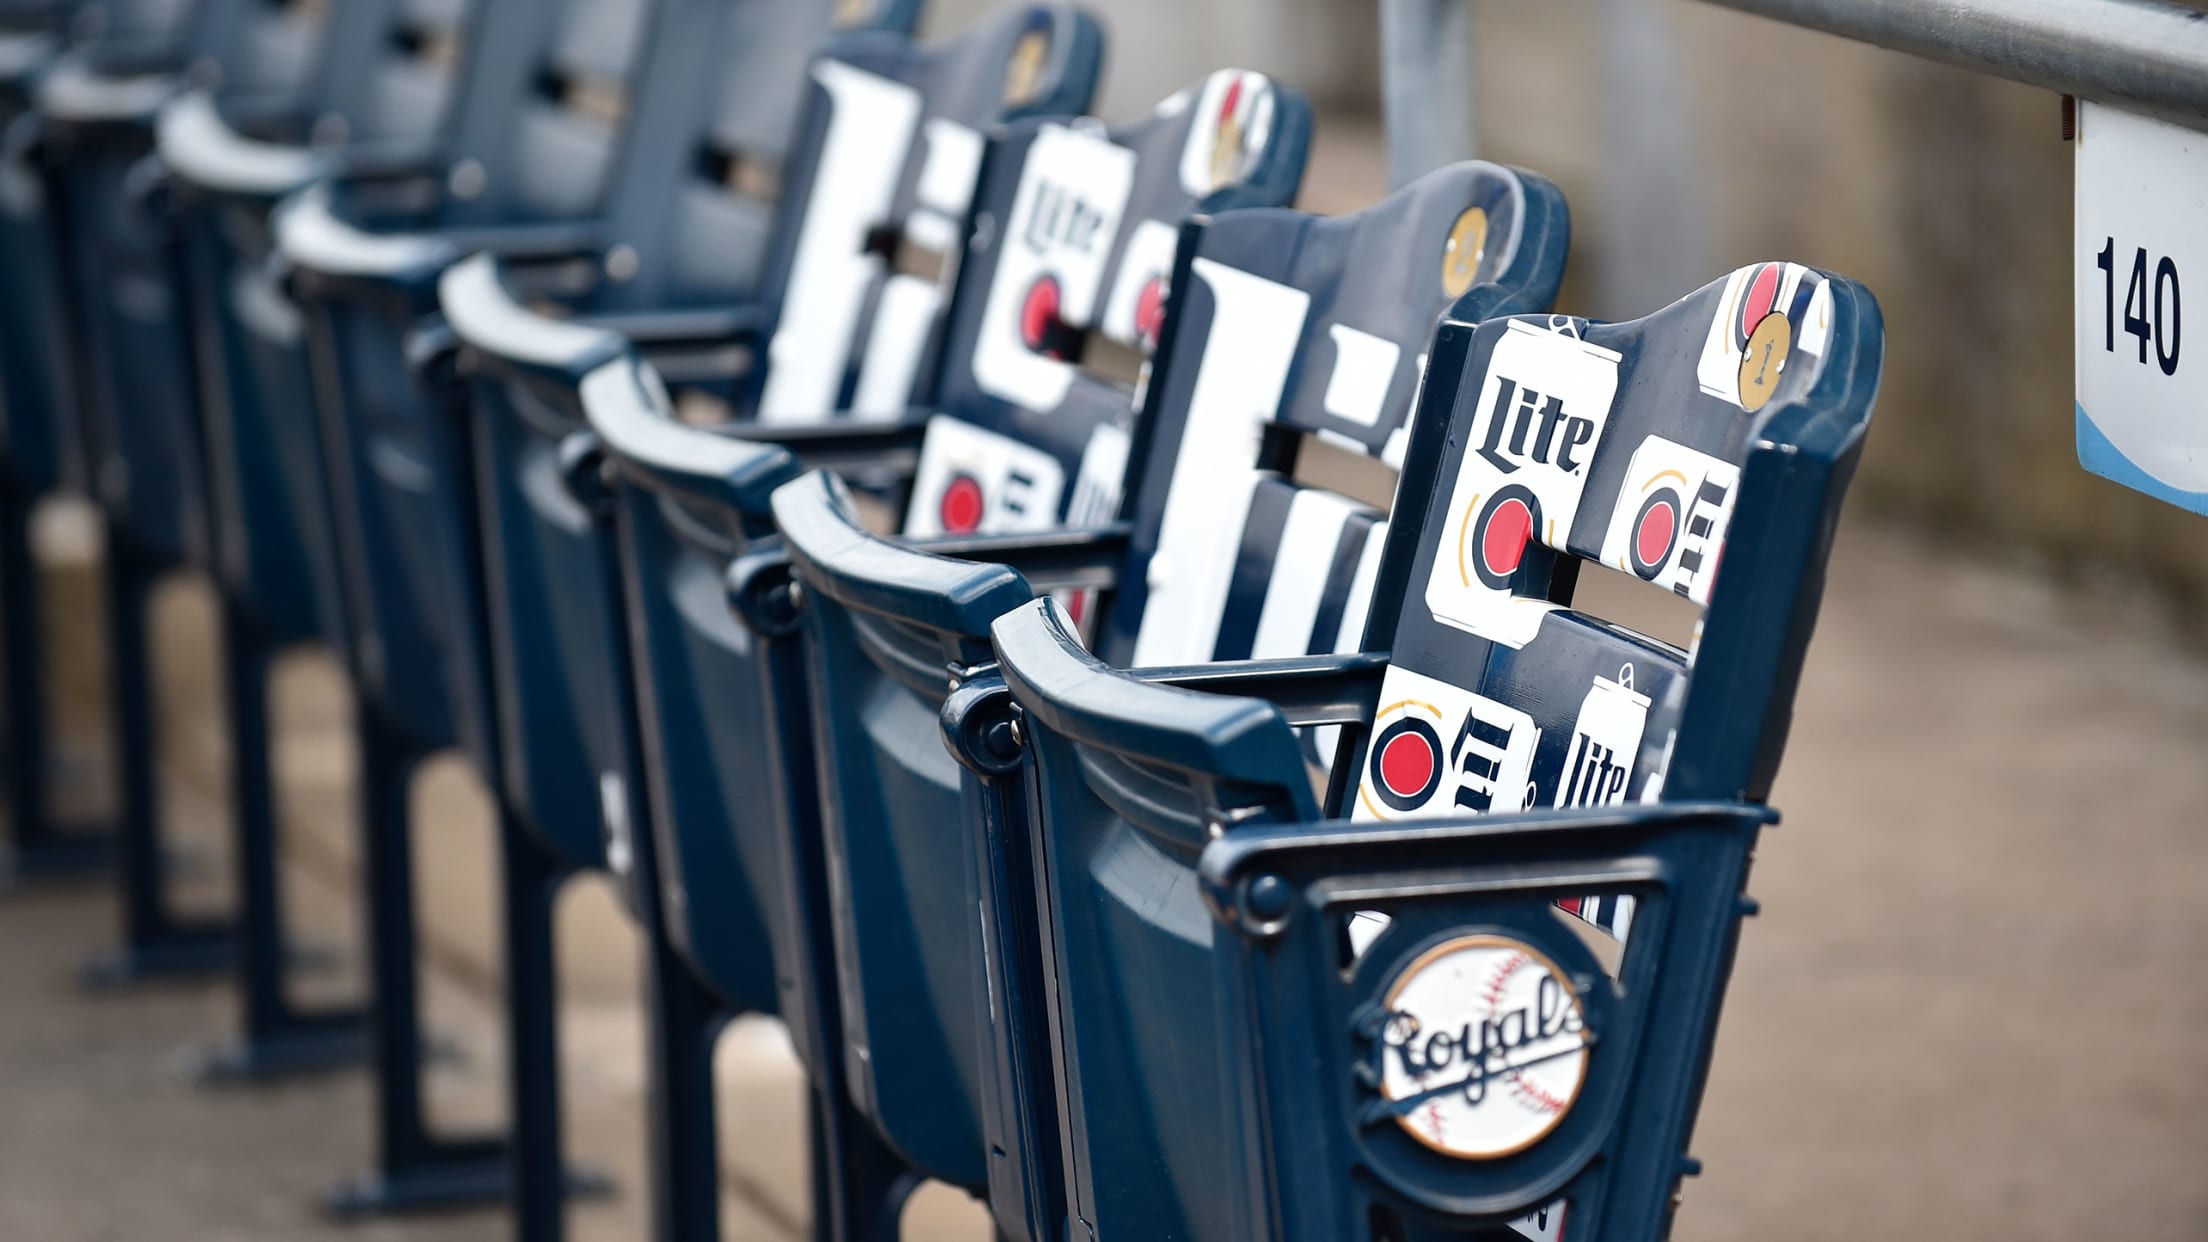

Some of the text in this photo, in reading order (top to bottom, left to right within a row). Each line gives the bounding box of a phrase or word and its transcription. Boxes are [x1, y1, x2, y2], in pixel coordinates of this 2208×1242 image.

[1753, 338, 1775, 386] 1
[2097, 236, 2181, 376] 140
[1475, 375, 1595, 476] Lite
[1361, 973, 1592, 1107] Royals
